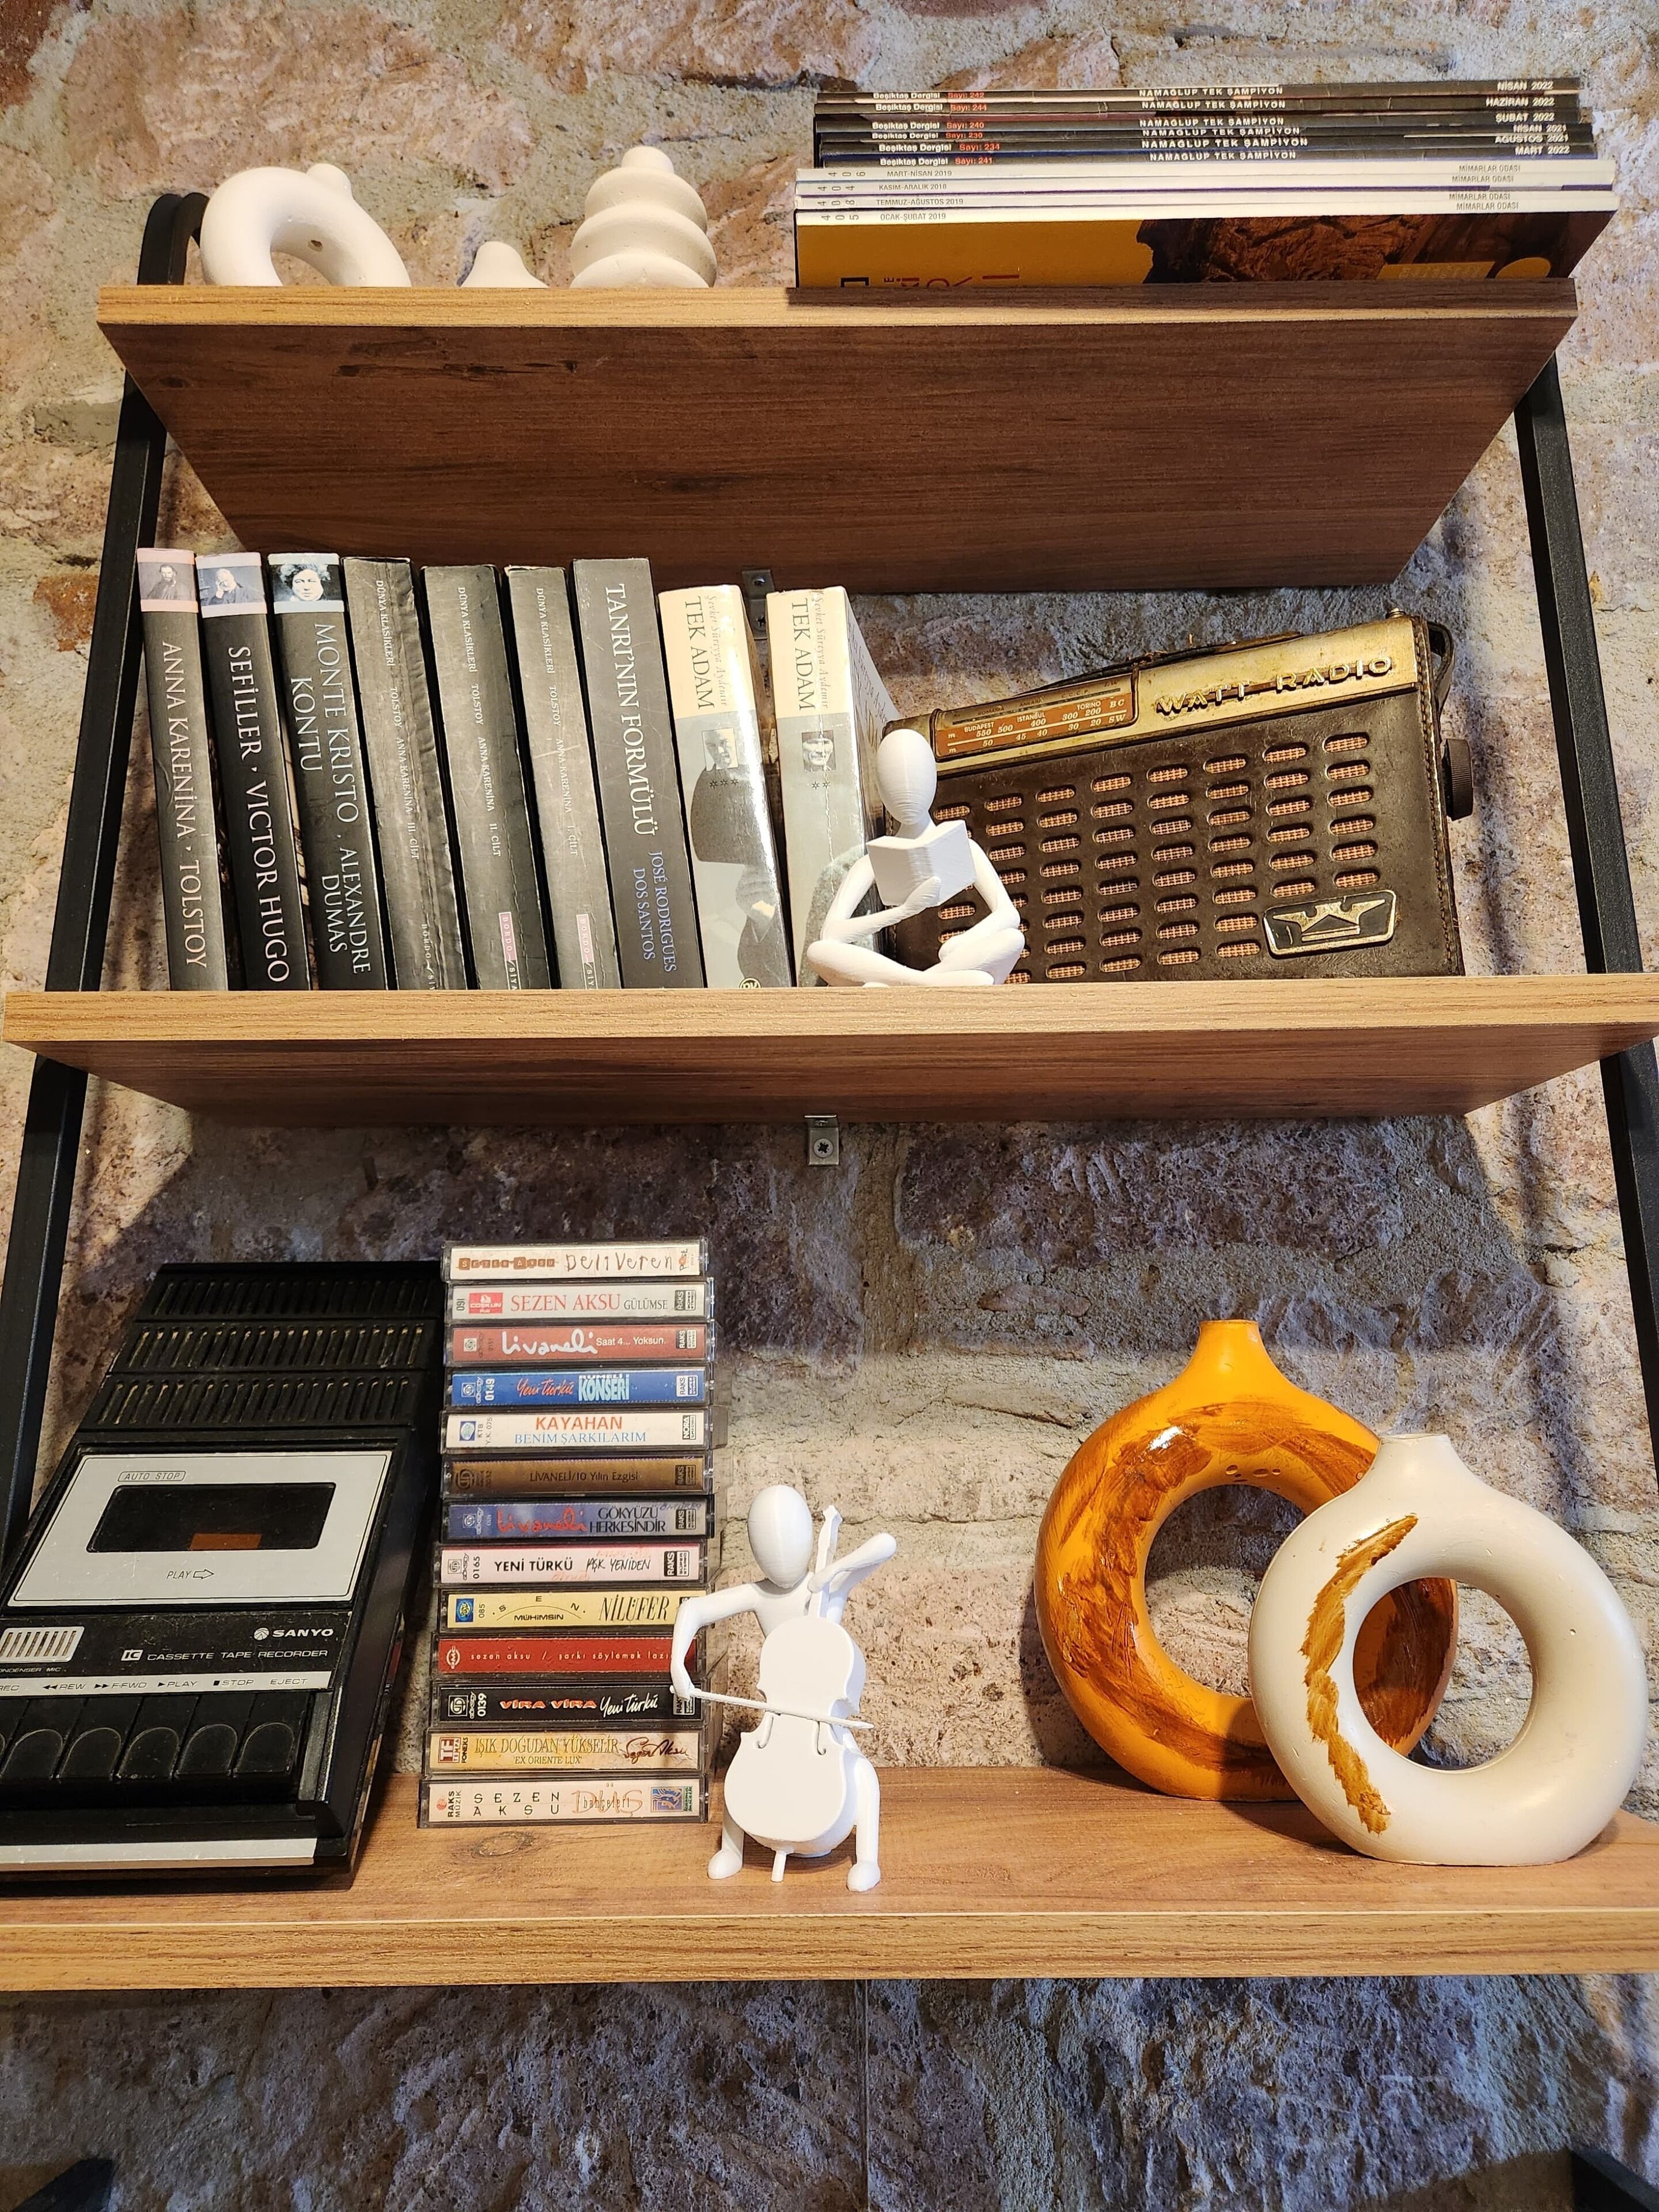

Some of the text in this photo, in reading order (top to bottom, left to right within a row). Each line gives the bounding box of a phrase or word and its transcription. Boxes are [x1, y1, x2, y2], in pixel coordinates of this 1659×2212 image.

[459, 587, 469, 618] DÜNYA
[463, 620, 478, 673] KLASİKLERİ
[685, 596, 715, 709] TEK ADAM
[791, 598, 816, 711] TEK ADAM
[1157, 656, 1392, 714] WATT RADIO
[390, 686, 403, 729] TOLSTOY
[471, 683, 484, 725] TOLSTOY
[541, 621, 572, 813] KLASİKLERİ TOLSTOY ANNA KARENİNA
[1077, 700, 1101, 711] TORINO
[290, 676, 322, 772] KONTU
[315, 622, 359, 824] MONTE KRISTO
[964, 722, 994, 733] BUDAPEST
[976, 729, 991, 738] 550
[997, 724, 1013, 734] 500
[1031, 718, 1046, 728] 400
[1062, 711, 1078, 721] 300
[1085, 707, 1101, 717] 200
[983, 739, 993, 747] 50
[1016, 733, 1027, 741] 45
[1036, 729, 1048, 737] 40
[1068, 722, 1079, 731] 30
[1090, 718, 1101, 727] 20
[396, 737, 407, 763] ANNA
[478, 737, 488, 762] ANNA
[483, 764, 495, 811] KARENİNA
[621, 712, 656, 836] FORMÜLÜ
[162, 641, 207, 970] ANNA KARENİNA TOLSTOY
[229, 646, 290, 983] SEFİLLER VICTOR HUGO
[321, 874, 347, 953] DUMAS
[340, 847, 371, 974] ALEXANDRE
[633, 868, 656, 961] DOS SANTOS
[648, 850, 677, 974] JOSÉ RODRIGUES
[502, 916, 513, 951] BORDO
[579, 918, 590, 954] BORDO
[510, 1294, 668, 1312] SEZEN AKSU GÜLÜMSE
[596, 1338, 615, 1346] Saat
[633, 1337, 666, 1345] Yoksun.
[485, 1378, 495, 1401] 0149
[578, 1374, 630, 1401] KONSERİ
[536, 1416, 623, 1430] KAYAHAN
[515, 1431, 646, 1445] BENİM ŞARKILARIM
[590, 1471, 638, 1483] Yılın Ezgisi
[590, 1518, 665, 1533] HERKESİNDİR
[599, 1505, 658, 1519] GÖKYÜZÜ
[166, 1571, 192, 1579] PLAY
[494, 1557, 573, 1572] YENİ TÜRKÜ
[610, 1556, 651, 1571] YENİDEN
[599, 1594, 669, 1622] NİLÜFER
[272, 1628, 334, 1637] SANYO
[147, 1652, 214, 1661] CASSETTE
[258, 1650, 328, 1658] RECORDER
[507, 1652, 531, 1660] aksu
[592, 1650, 641, 1661] söylemek
[478, 1692, 487, 1717] 0139
[600, 1692, 659, 1718] Yeni Türkü
[475, 1735, 619, 1758] IŞIK DOĞUDAN YÜKSELİR
